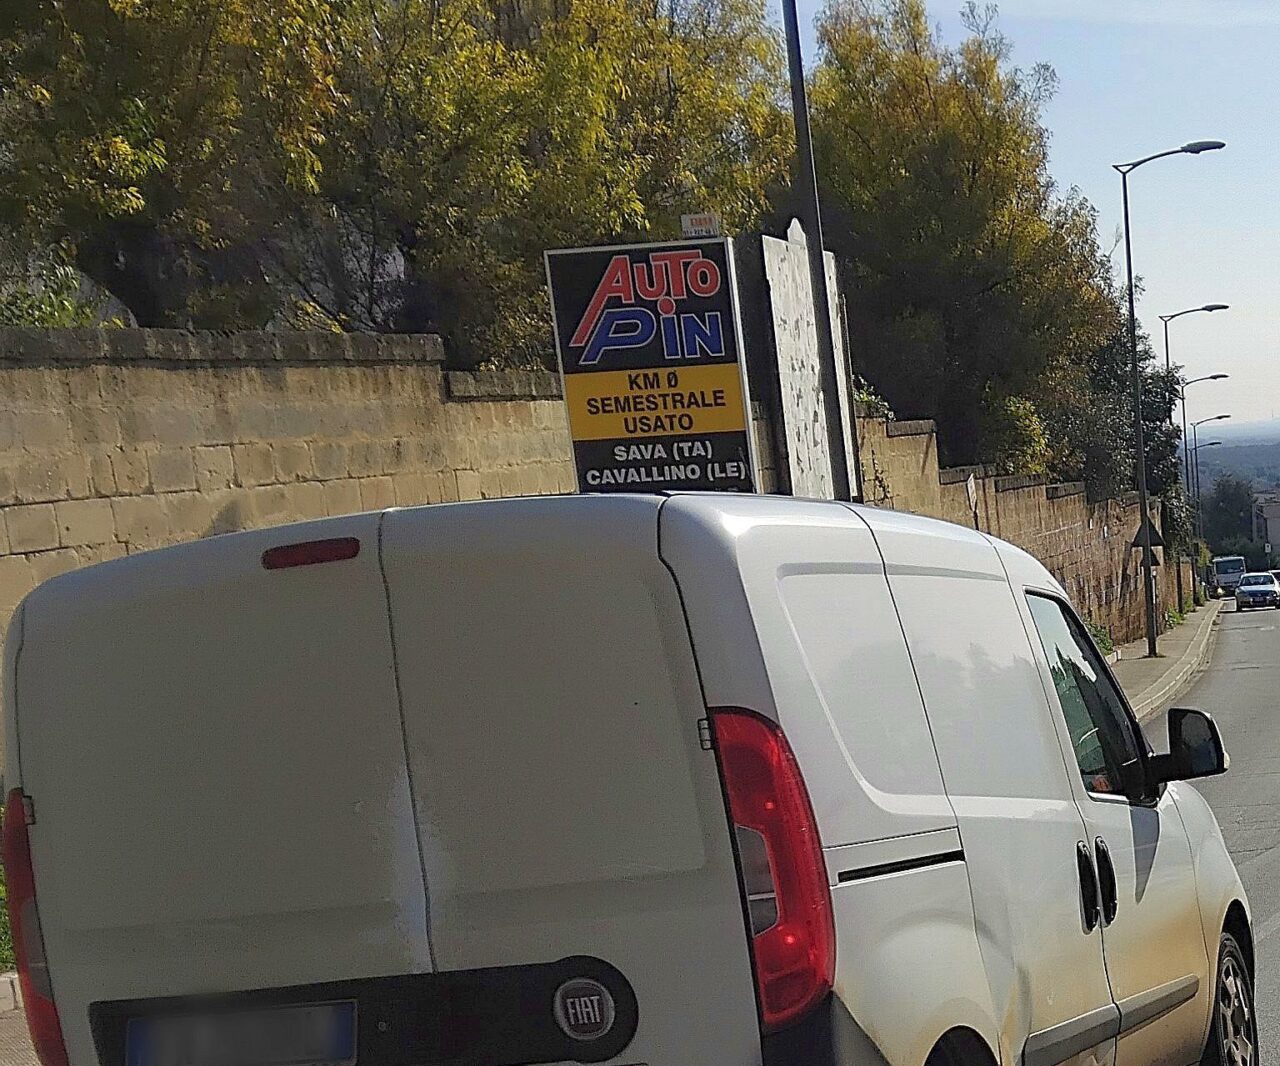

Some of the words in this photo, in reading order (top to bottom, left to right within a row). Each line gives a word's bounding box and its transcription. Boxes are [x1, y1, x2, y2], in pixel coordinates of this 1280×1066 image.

[628, 373, 660, 391] KM
[587, 389, 726, 415] SEMESTRALE
[623, 413, 694, 434] USATO
[614, 444, 667, 461] SAVA
[673, 441, 712, 460] (TA)
[586, 465, 701, 485] CAVALLINO
[707, 461, 746, 481] (LE)
[566, 996, 600, 1025] FIAT
